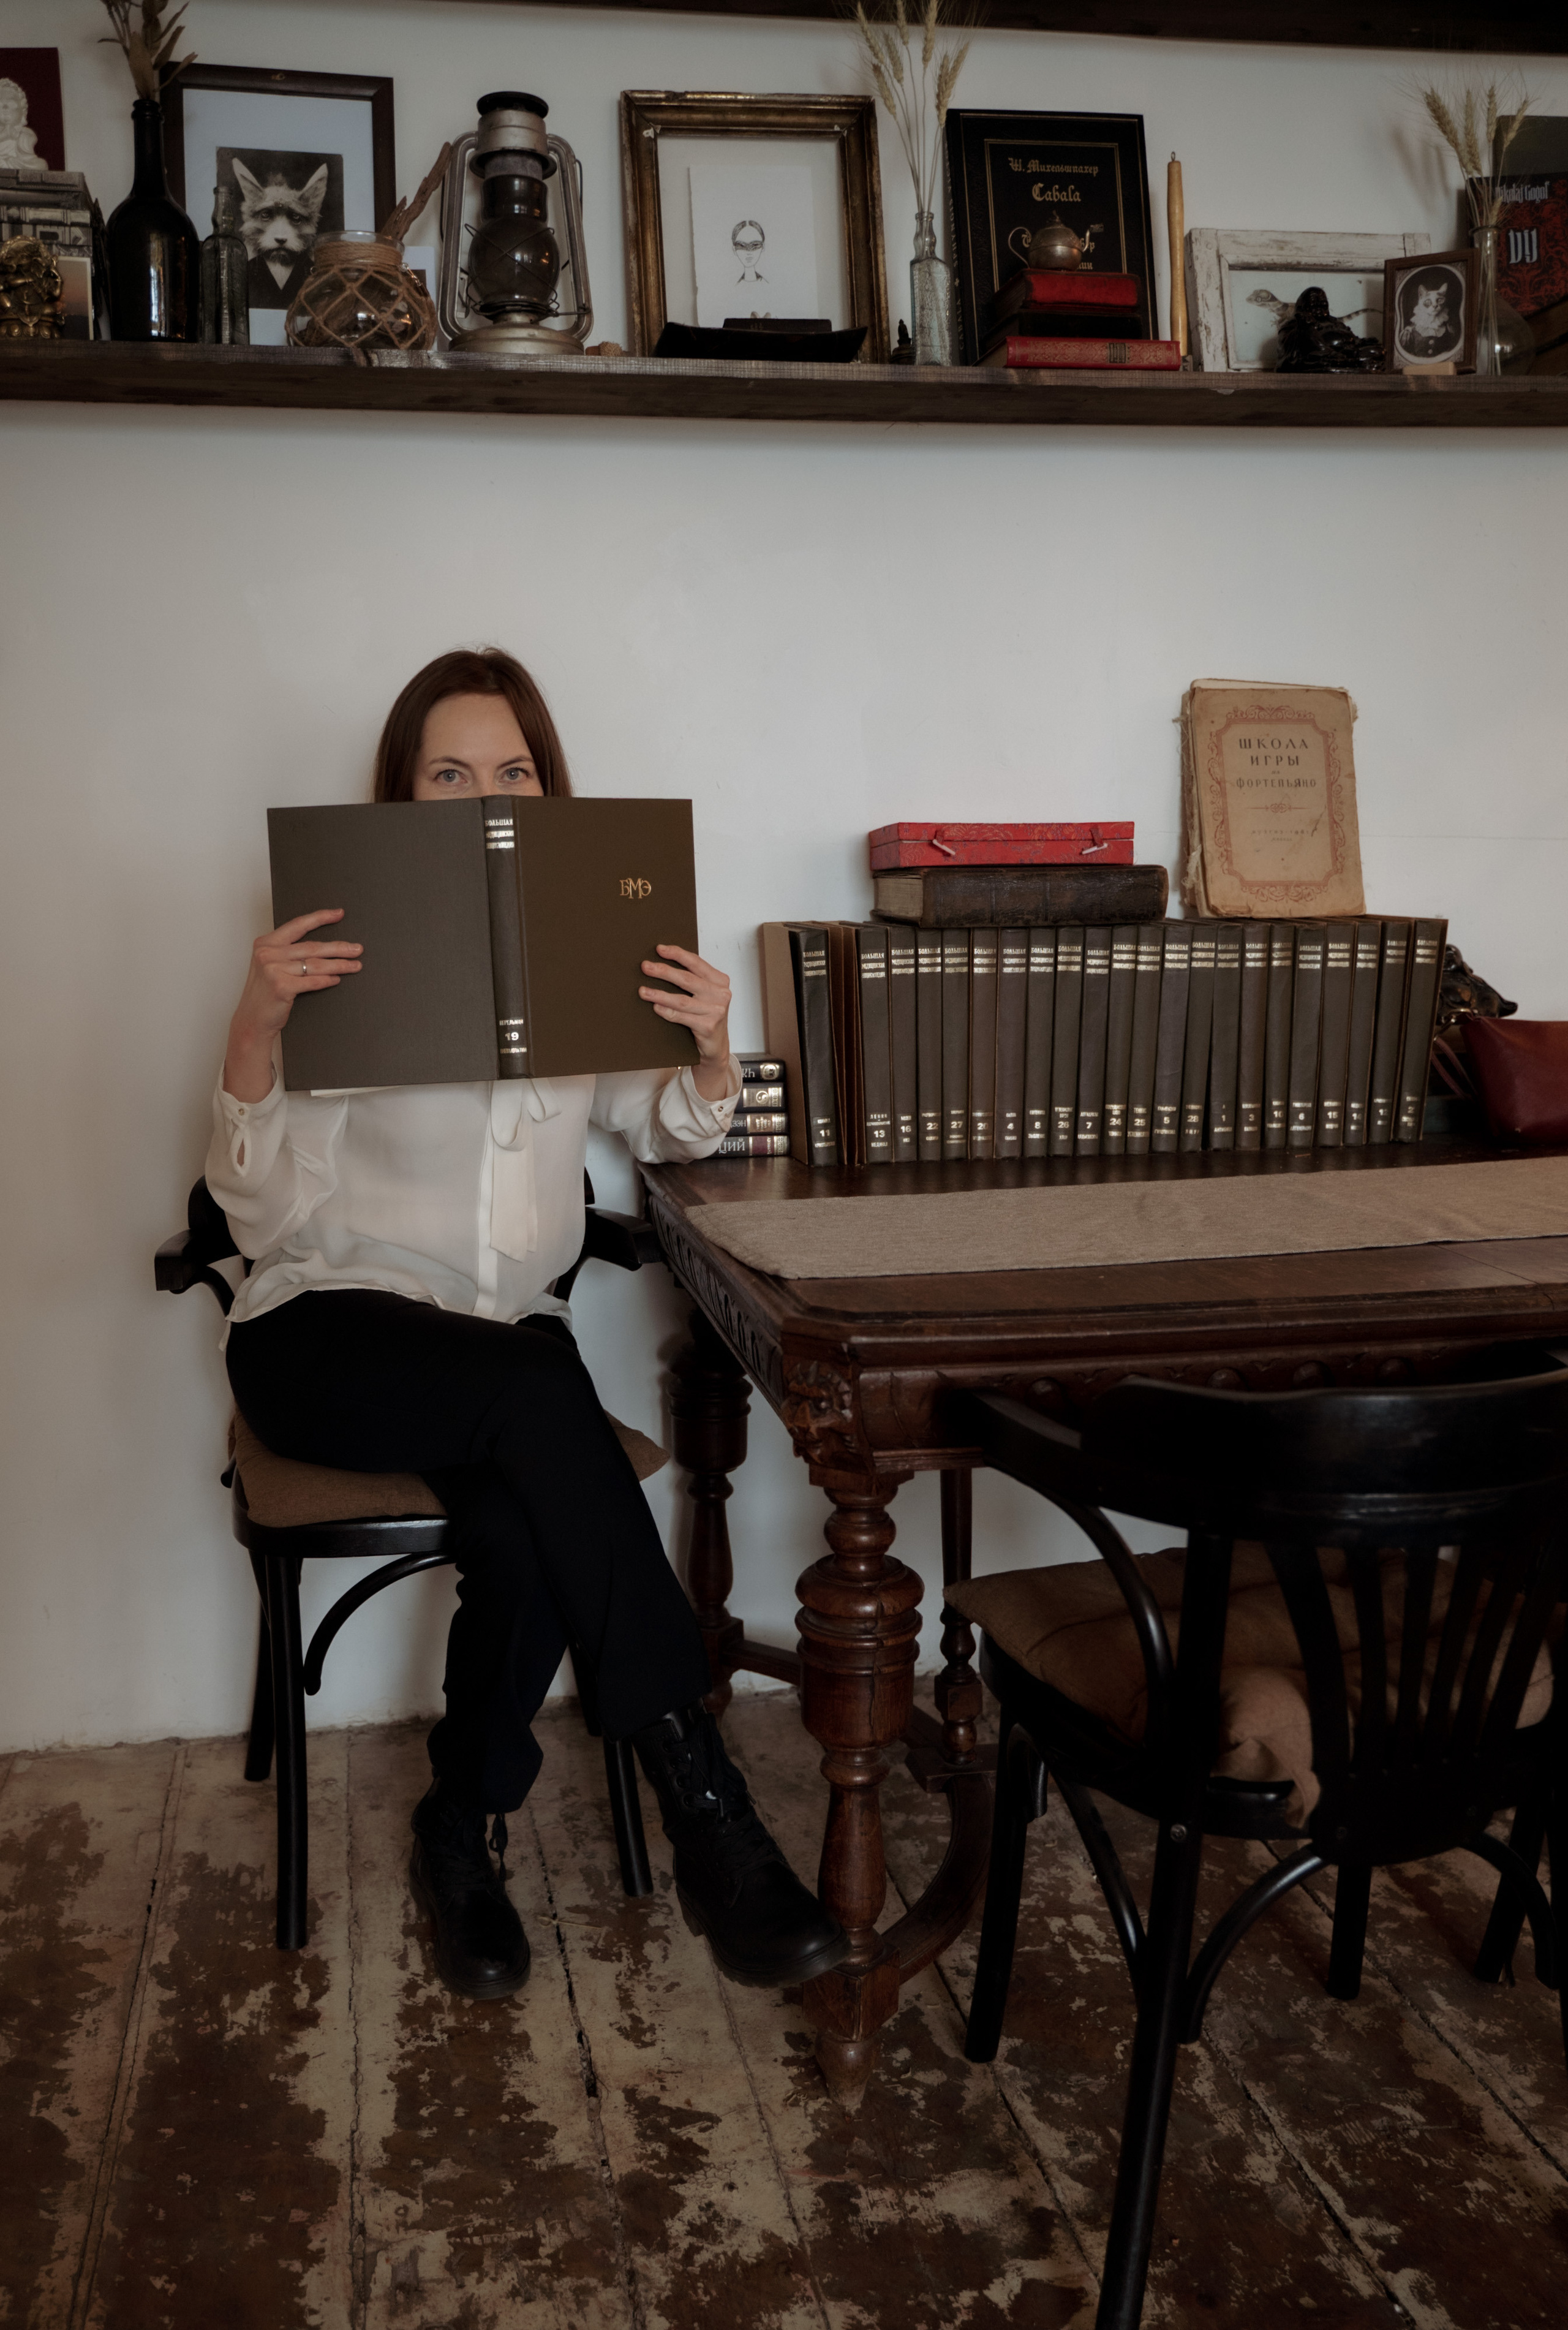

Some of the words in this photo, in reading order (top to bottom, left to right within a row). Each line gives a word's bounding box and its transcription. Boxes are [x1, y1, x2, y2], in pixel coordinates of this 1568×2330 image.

[1031, 183, 1082, 203] Cabala
[1238, 738, 1309, 749] ШКОЛА
[1250, 755, 1299, 766] ИГРЫ
[1236, 777, 1316, 789] ФОРТЕПЬЯНО
[484, 818, 514, 827] БОЛЬШАЯ
[619, 877, 652, 899] БМЭ
[505, 1031, 519, 1042] 19
[730, 1120, 747, 1130] ЗЭН
[900, 1125, 911, 1133] 16
[926, 1122, 938, 1130] 22
[718, 1138, 746, 1154] ЦИЙ
